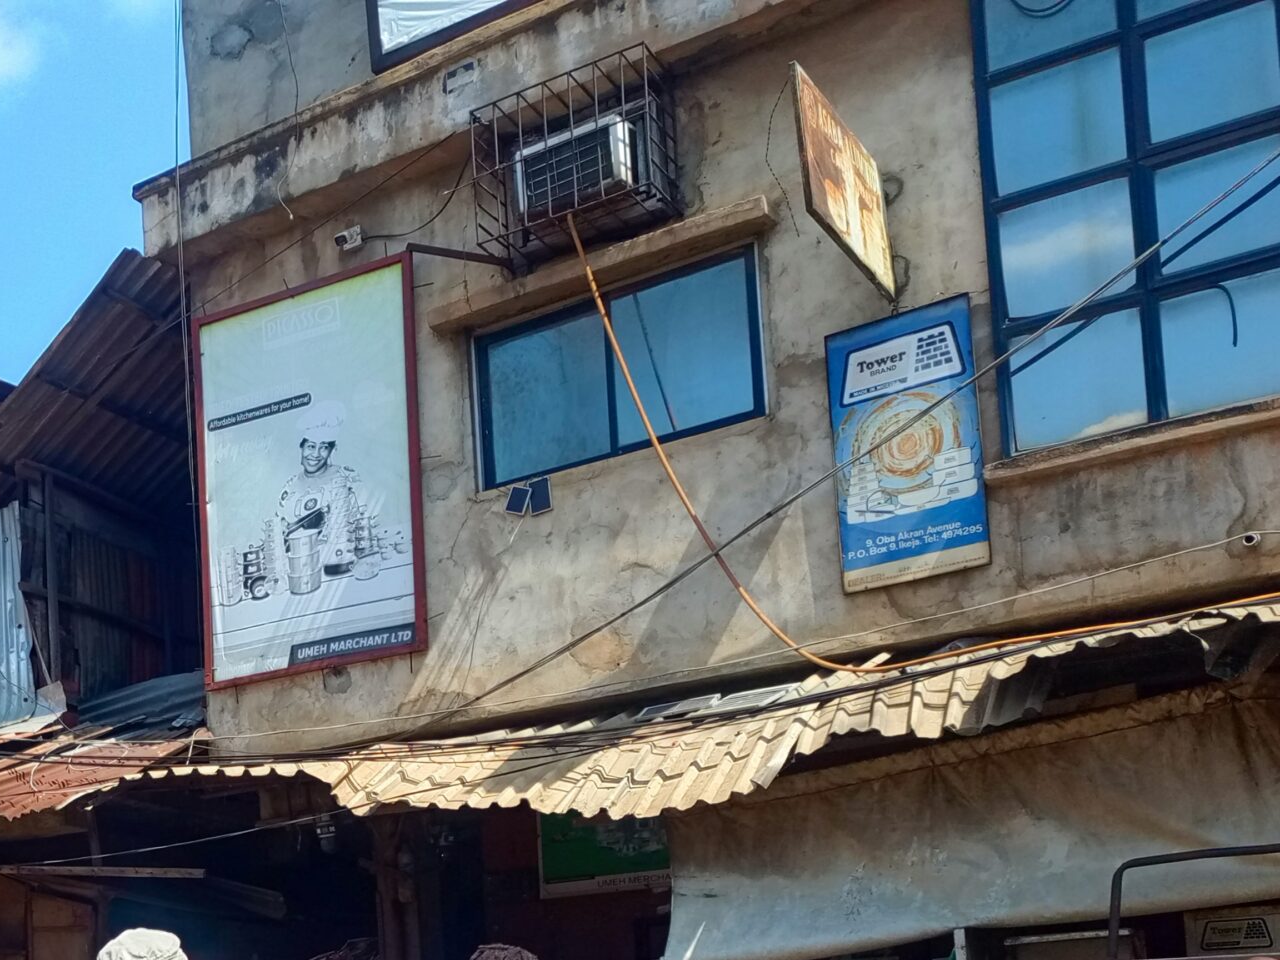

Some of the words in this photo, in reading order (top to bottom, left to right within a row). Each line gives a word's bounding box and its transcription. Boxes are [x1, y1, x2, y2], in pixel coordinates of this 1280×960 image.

[267, 303, 335, 338] PICASSO
[856, 350, 908, 374] Tower
[869, 364, 898, 377] BRAND
[209, 415, 236, 430] Affordable
[236, 407, 271, 422] kitchenwares
[271, 404, 279, 412] for
[279, 401, 292, 412] your
[876, 535, 896, 545] Oba
[898, 529, 924, 541] Akran
[926, 522, 962, 534] Avenue
[924, 534, 940, 544] Tel:
[941, 524, 984, 540] 4974295
[297, 643, 327, 659] UMEH
[329, 633, 389, 653] MARCHANT
[390, 630, 412, 643] LTD
[597, 877, 626, 888] UMEH
[1209, 926, 1243, 935] Tower
